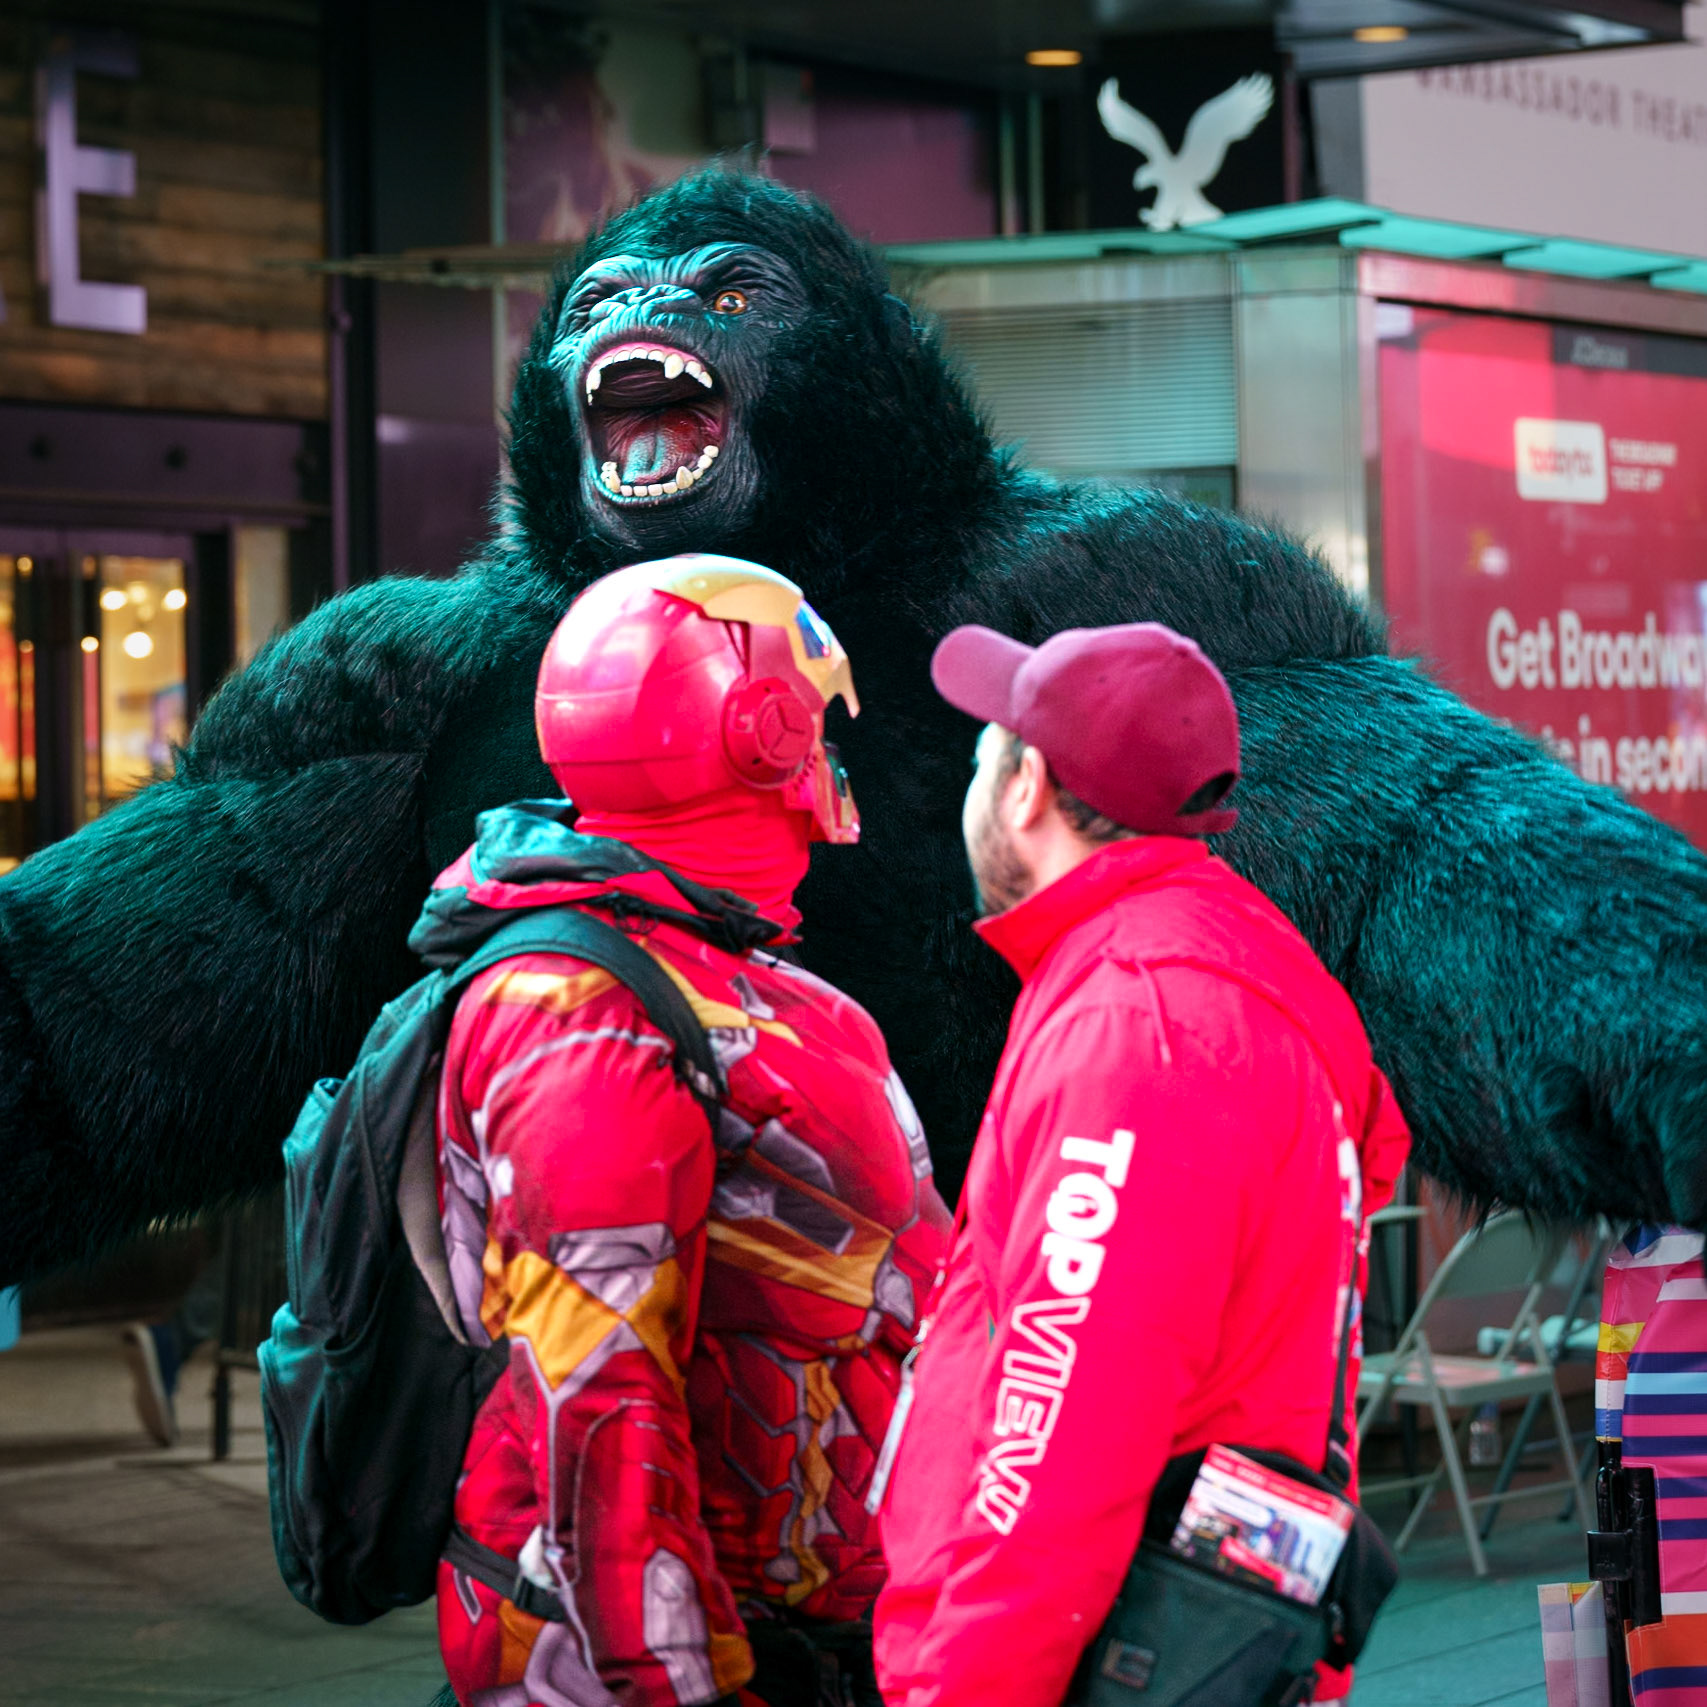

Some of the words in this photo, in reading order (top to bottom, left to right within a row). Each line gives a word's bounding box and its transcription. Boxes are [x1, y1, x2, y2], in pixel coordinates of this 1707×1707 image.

[0, 36, 147, 334] E
[1486, 606, 1556, 690] Get
[1558, 608, 1707, 691] Broadwa
[1577, 712, 1612, 786] in
